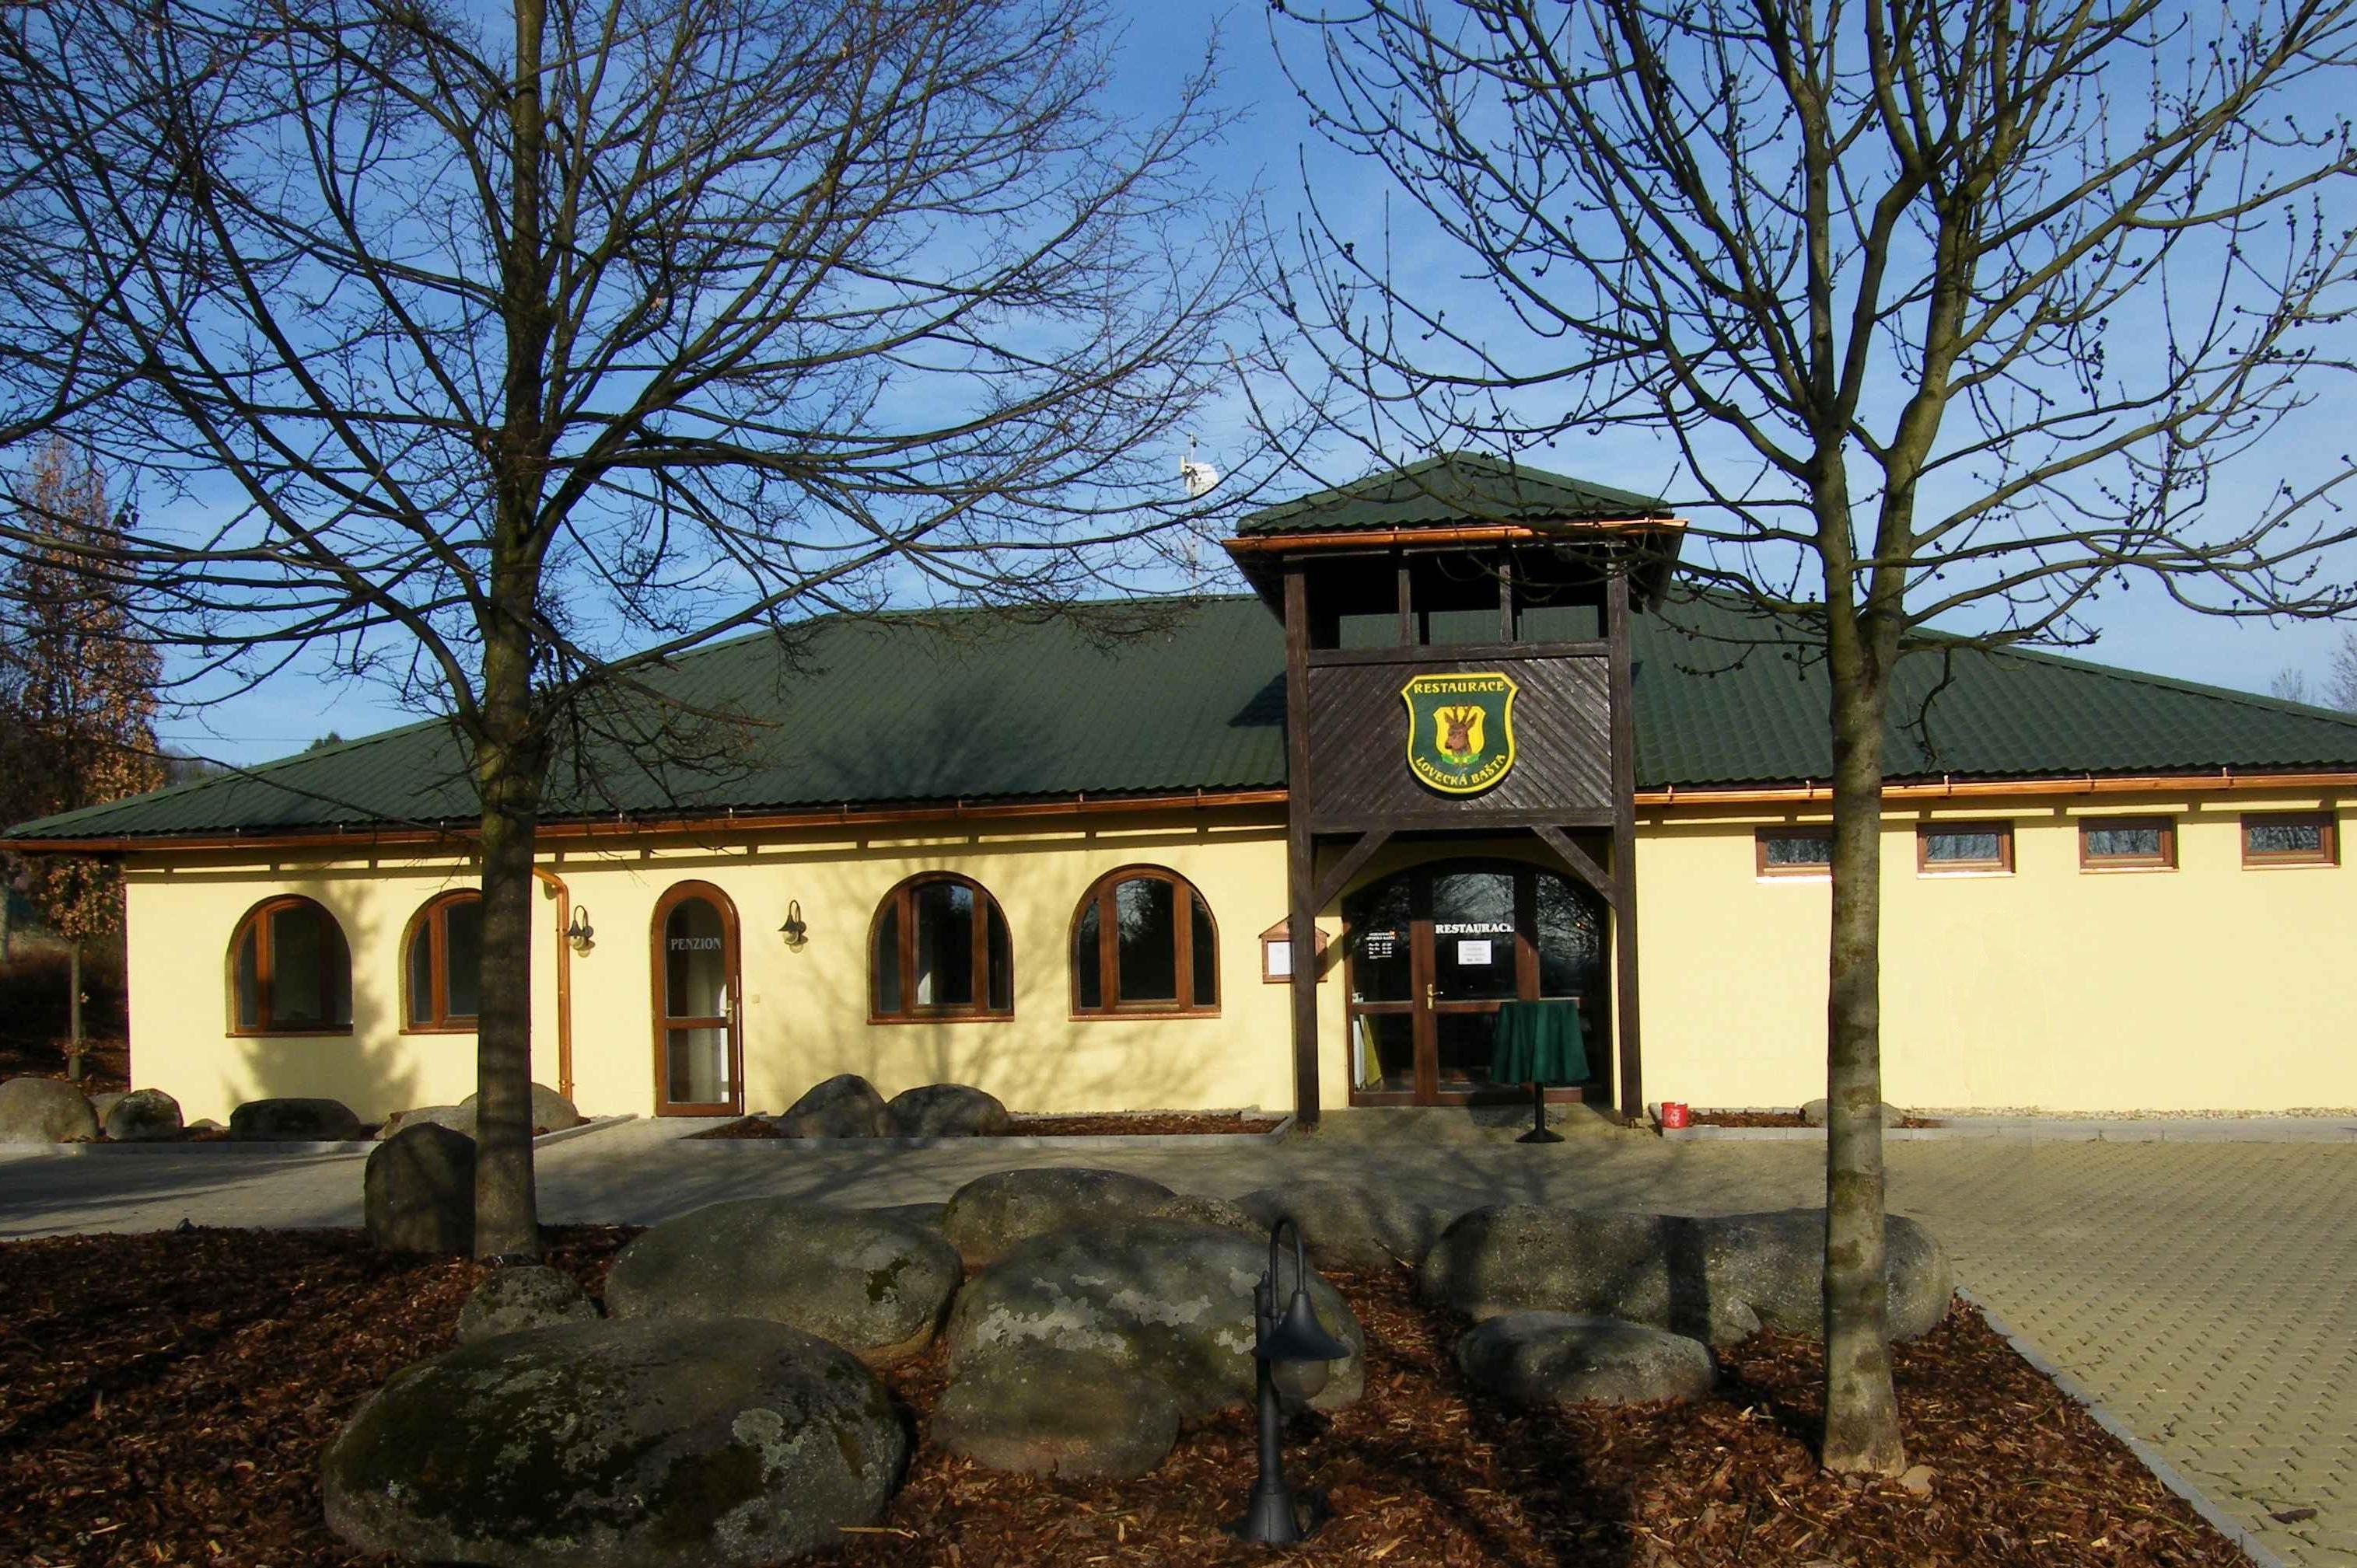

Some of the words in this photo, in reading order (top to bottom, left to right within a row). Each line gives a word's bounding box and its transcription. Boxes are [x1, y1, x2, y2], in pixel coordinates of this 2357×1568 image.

[1414, 681, 1505, 694] RESTAURACE
[1415, 756, 1467, 785] LOVECKÁ
[1471, 754, 1506, 783] BAŠTA
[670, 938, 722, 950] PENZION
